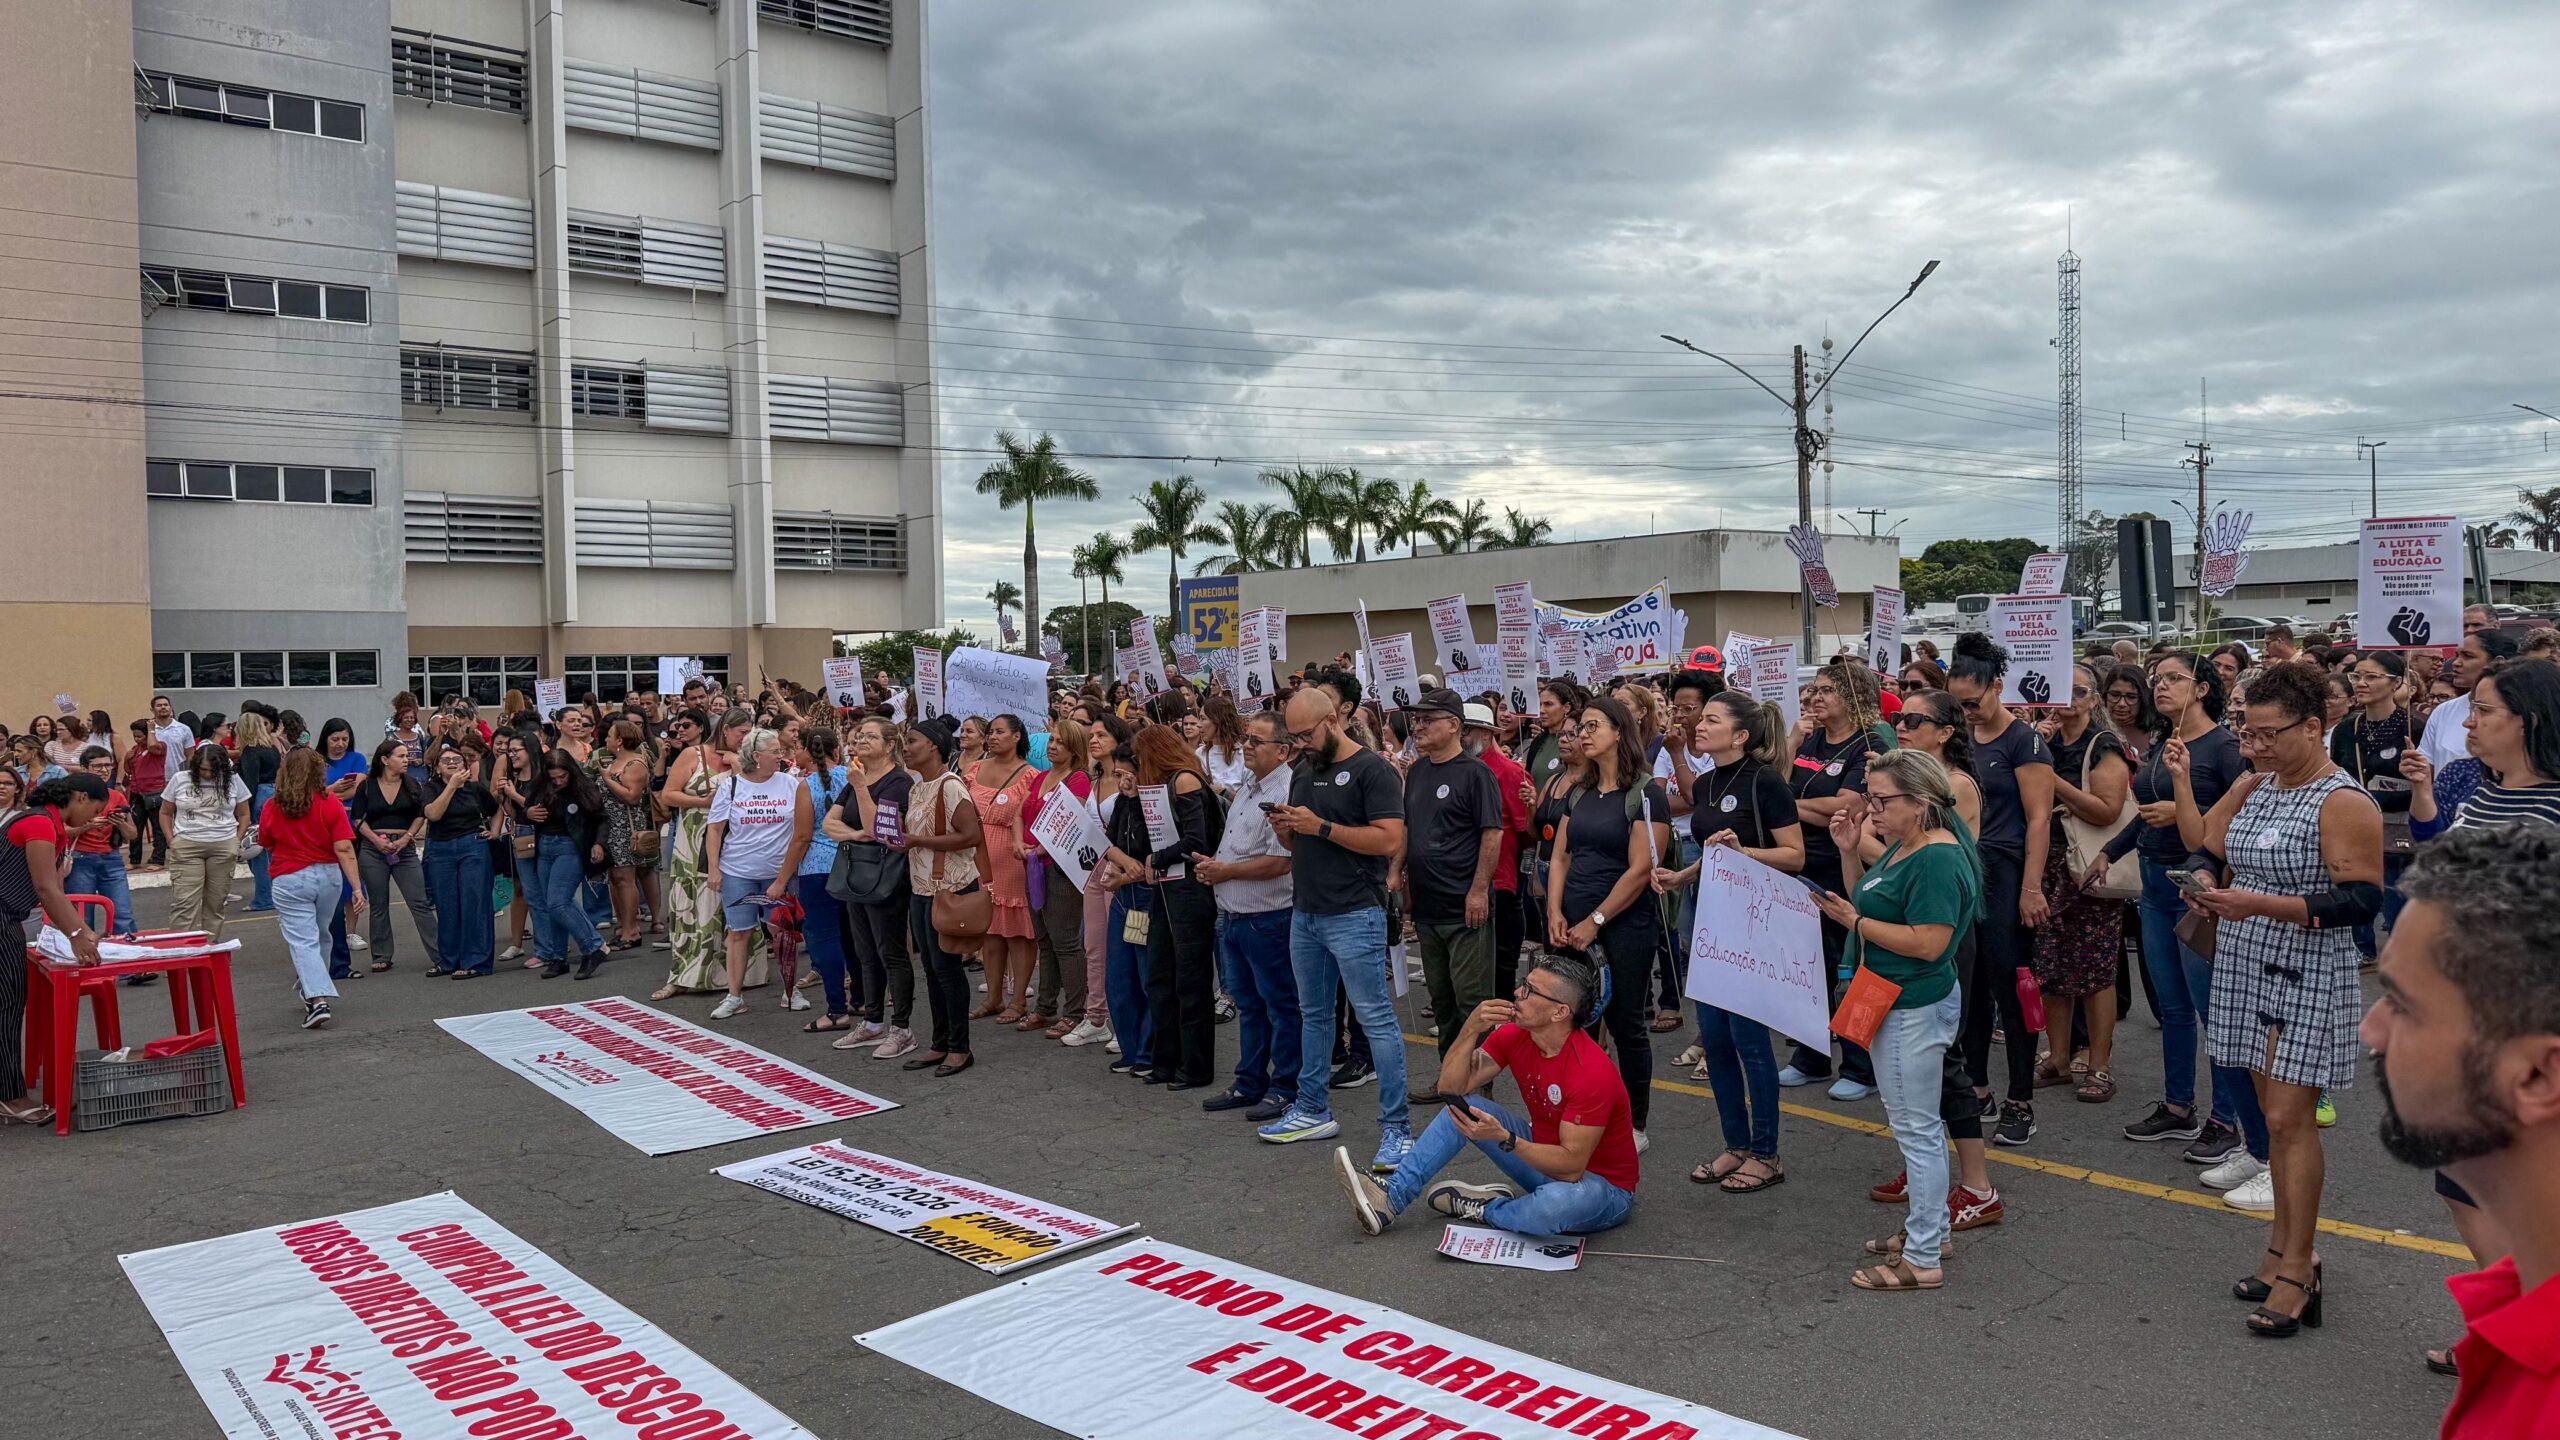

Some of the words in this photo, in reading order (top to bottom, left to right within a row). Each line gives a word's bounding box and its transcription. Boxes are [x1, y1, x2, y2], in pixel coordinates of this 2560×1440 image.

[2378, 541, 2386, 549] A
[2390, 539, 2423, 548] LUTA
[2427, 536, 2436, 547] É
[2392, 548, 2424, 557] PELA
[2373, 556, 2442, 568] EDUCAÇÃO
[1189, 586, 1228, 599] APARECIDA
[1645, 591, 1658, 610] é
[1194, 607, 1229, 642] 52%
[2018, 614, 2043, 622] LUTA
[2046, 612, 2052, 621] É
[2005, 629, 2058, 638] EDUCAÇÃO
[1757, 672, 1787, 682] EDUCAÇÃO
[740, 815, 785, 826] EDUCAÇÃO!
[747, 807, 764, 815] NÃO
[766, 807, 777, 815] HÁ
[877, 815, 889, 825] PLANO
[1050, 811, 1061, 828] LUTA
[1053, 815, 1065, 831] PELA
[1051, 811, 1074, 845] EDUCAÇÃO
[1696, 928, 1756, 972] Educação
[1758, 960, 1777, 980] na
[570, 1026, 674, 1066] VALORIZAÇÃO
[640, 1060, 704, 1079] REAL
[711, 1050, 767, 1069] PELO
[670, 1074, 725, 1089] DA
[735, 1063, 880, 1117] CUMPRIMENTO
[699, 1084, 815, 1131] EDUCAÇÃO!
[749, 1177, 778, 1189] SÃO
[788, 1157, 832, 1171] LEI
[819, 1166, 960, 1210] 15.326/2026
[804, 1180, 860, 1200] BRINCAR,
[856, 1196, 914, 1218] EDUCAR.
[941, 1185, 1026, 1213] APARECIDA
[1013, 1208, 1049, 1220] DE
[1037, 1216, 1105, 1239] GOIÂNI
[950, 1210, 993, 1220] É
[966, 1216, 1063, 1248] FUNÇÃO
[275, 1220, 389, 1282] NOSSOS
[897, 1225, 1013, 1265] DOCENTE!
[397, 1224, 529, 1294] CUMPRA
[471, 1283, 547, 1308] A
[1099, 1253, 1285, 1318] PLANO
[1259, 1302, 1367, 1344] DE
[329, 1272, 472, 1358] DIREITOS
[489, 1295, 585, 1334] LEI
[524, 1321, 622, 1361] DO
[1186, 1341, 1273, 1375] É
[406, 1346, 521, 1401] NÃO
[235, 1388, 249, 1398] DOS
